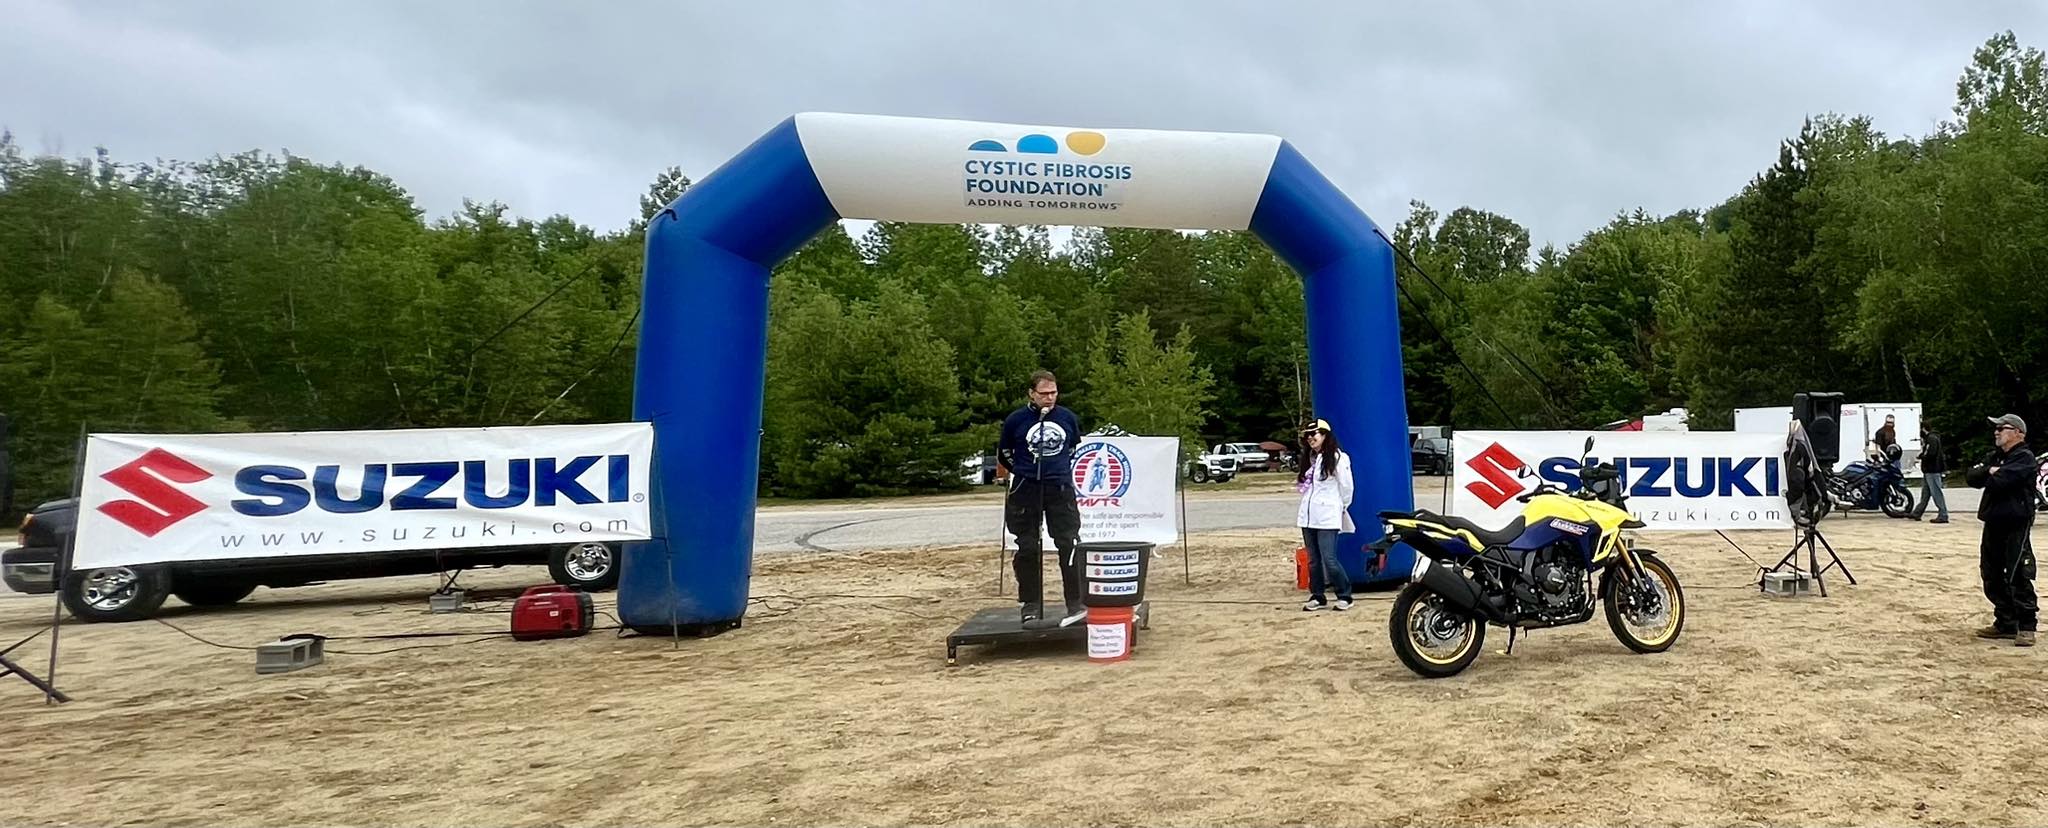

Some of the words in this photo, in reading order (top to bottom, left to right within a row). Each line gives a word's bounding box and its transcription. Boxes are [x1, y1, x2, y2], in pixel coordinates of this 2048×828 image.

[965, 160, 1037, 176] CYSTIC
[1043, 163, 1131, 180] FIBROSIS
[966, 179, 1102, 196] FOUNDATION
[967, 199, 1022, 208] ADDING
[1029, 200, 1118, 210] TOMORROWS
[231, 454, 629, 516] SUZUKI
[1119, 522, 1139, 531] sport
[221, 519, 628, 548] www.suzuki.com
[1103, 553, 1137, 561] SUZUKI
[1103, 567, 1137, 576] SUZUKI
[1103, 585, 1136, 593] SUZUKI
